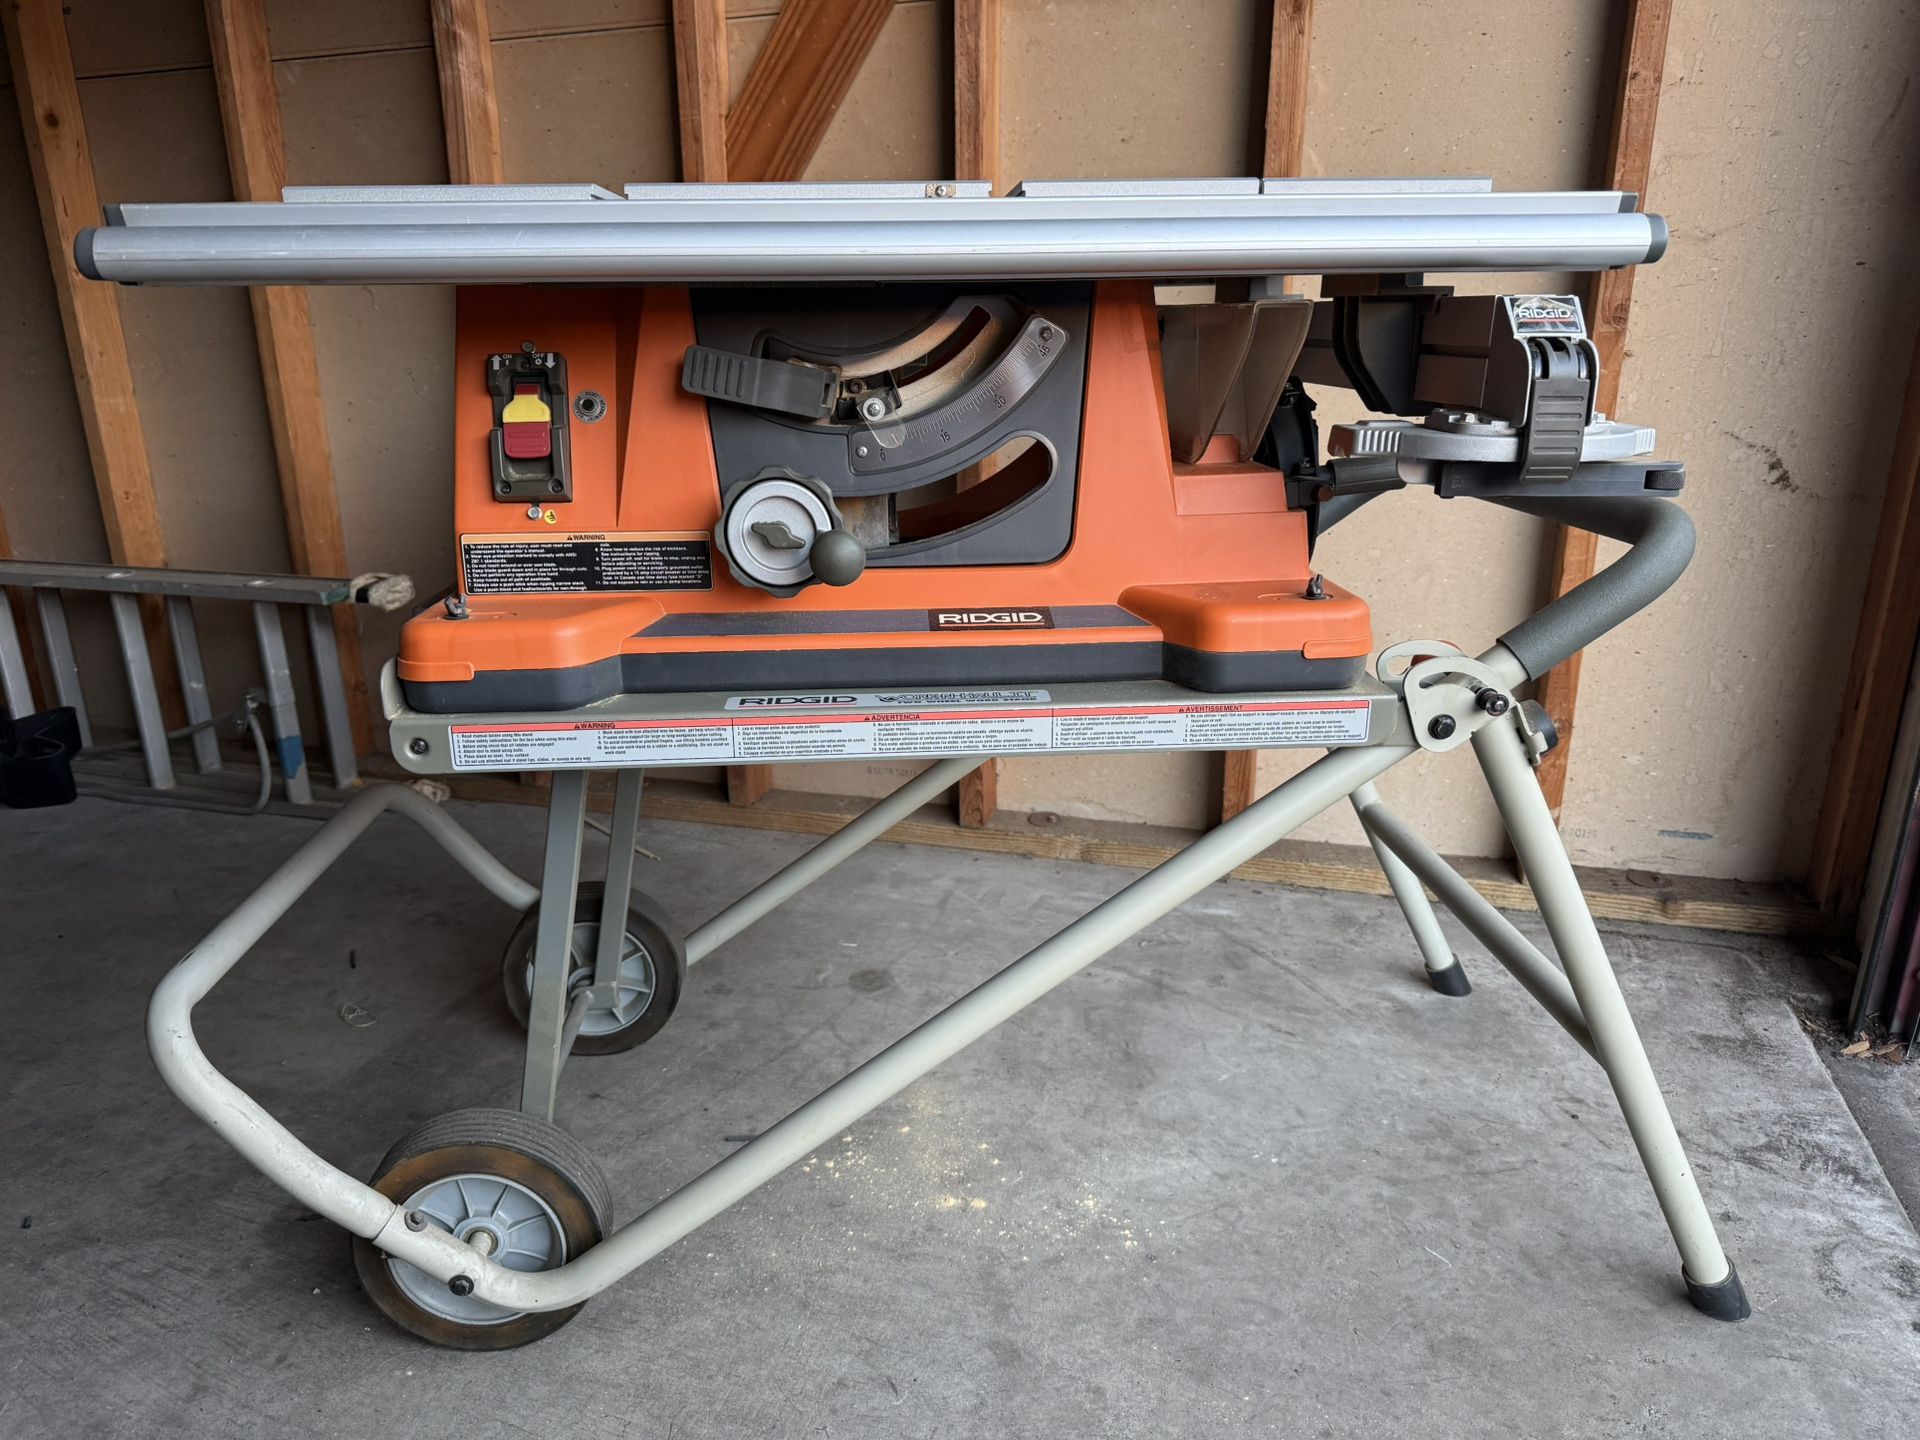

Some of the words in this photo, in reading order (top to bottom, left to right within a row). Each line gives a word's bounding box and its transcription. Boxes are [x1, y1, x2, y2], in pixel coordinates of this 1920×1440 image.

[1518, 308, 1570, 318] RIDGID
[1040, 345, 1050, 358] 45
[994, 396, 1006, 408] 30
[940, 432, 950, 442] 15
[880, 452, 886, 462] 0
[938, 612, 1043, 624] RIDGID
[739, 696, 858, 706] RIDGID
